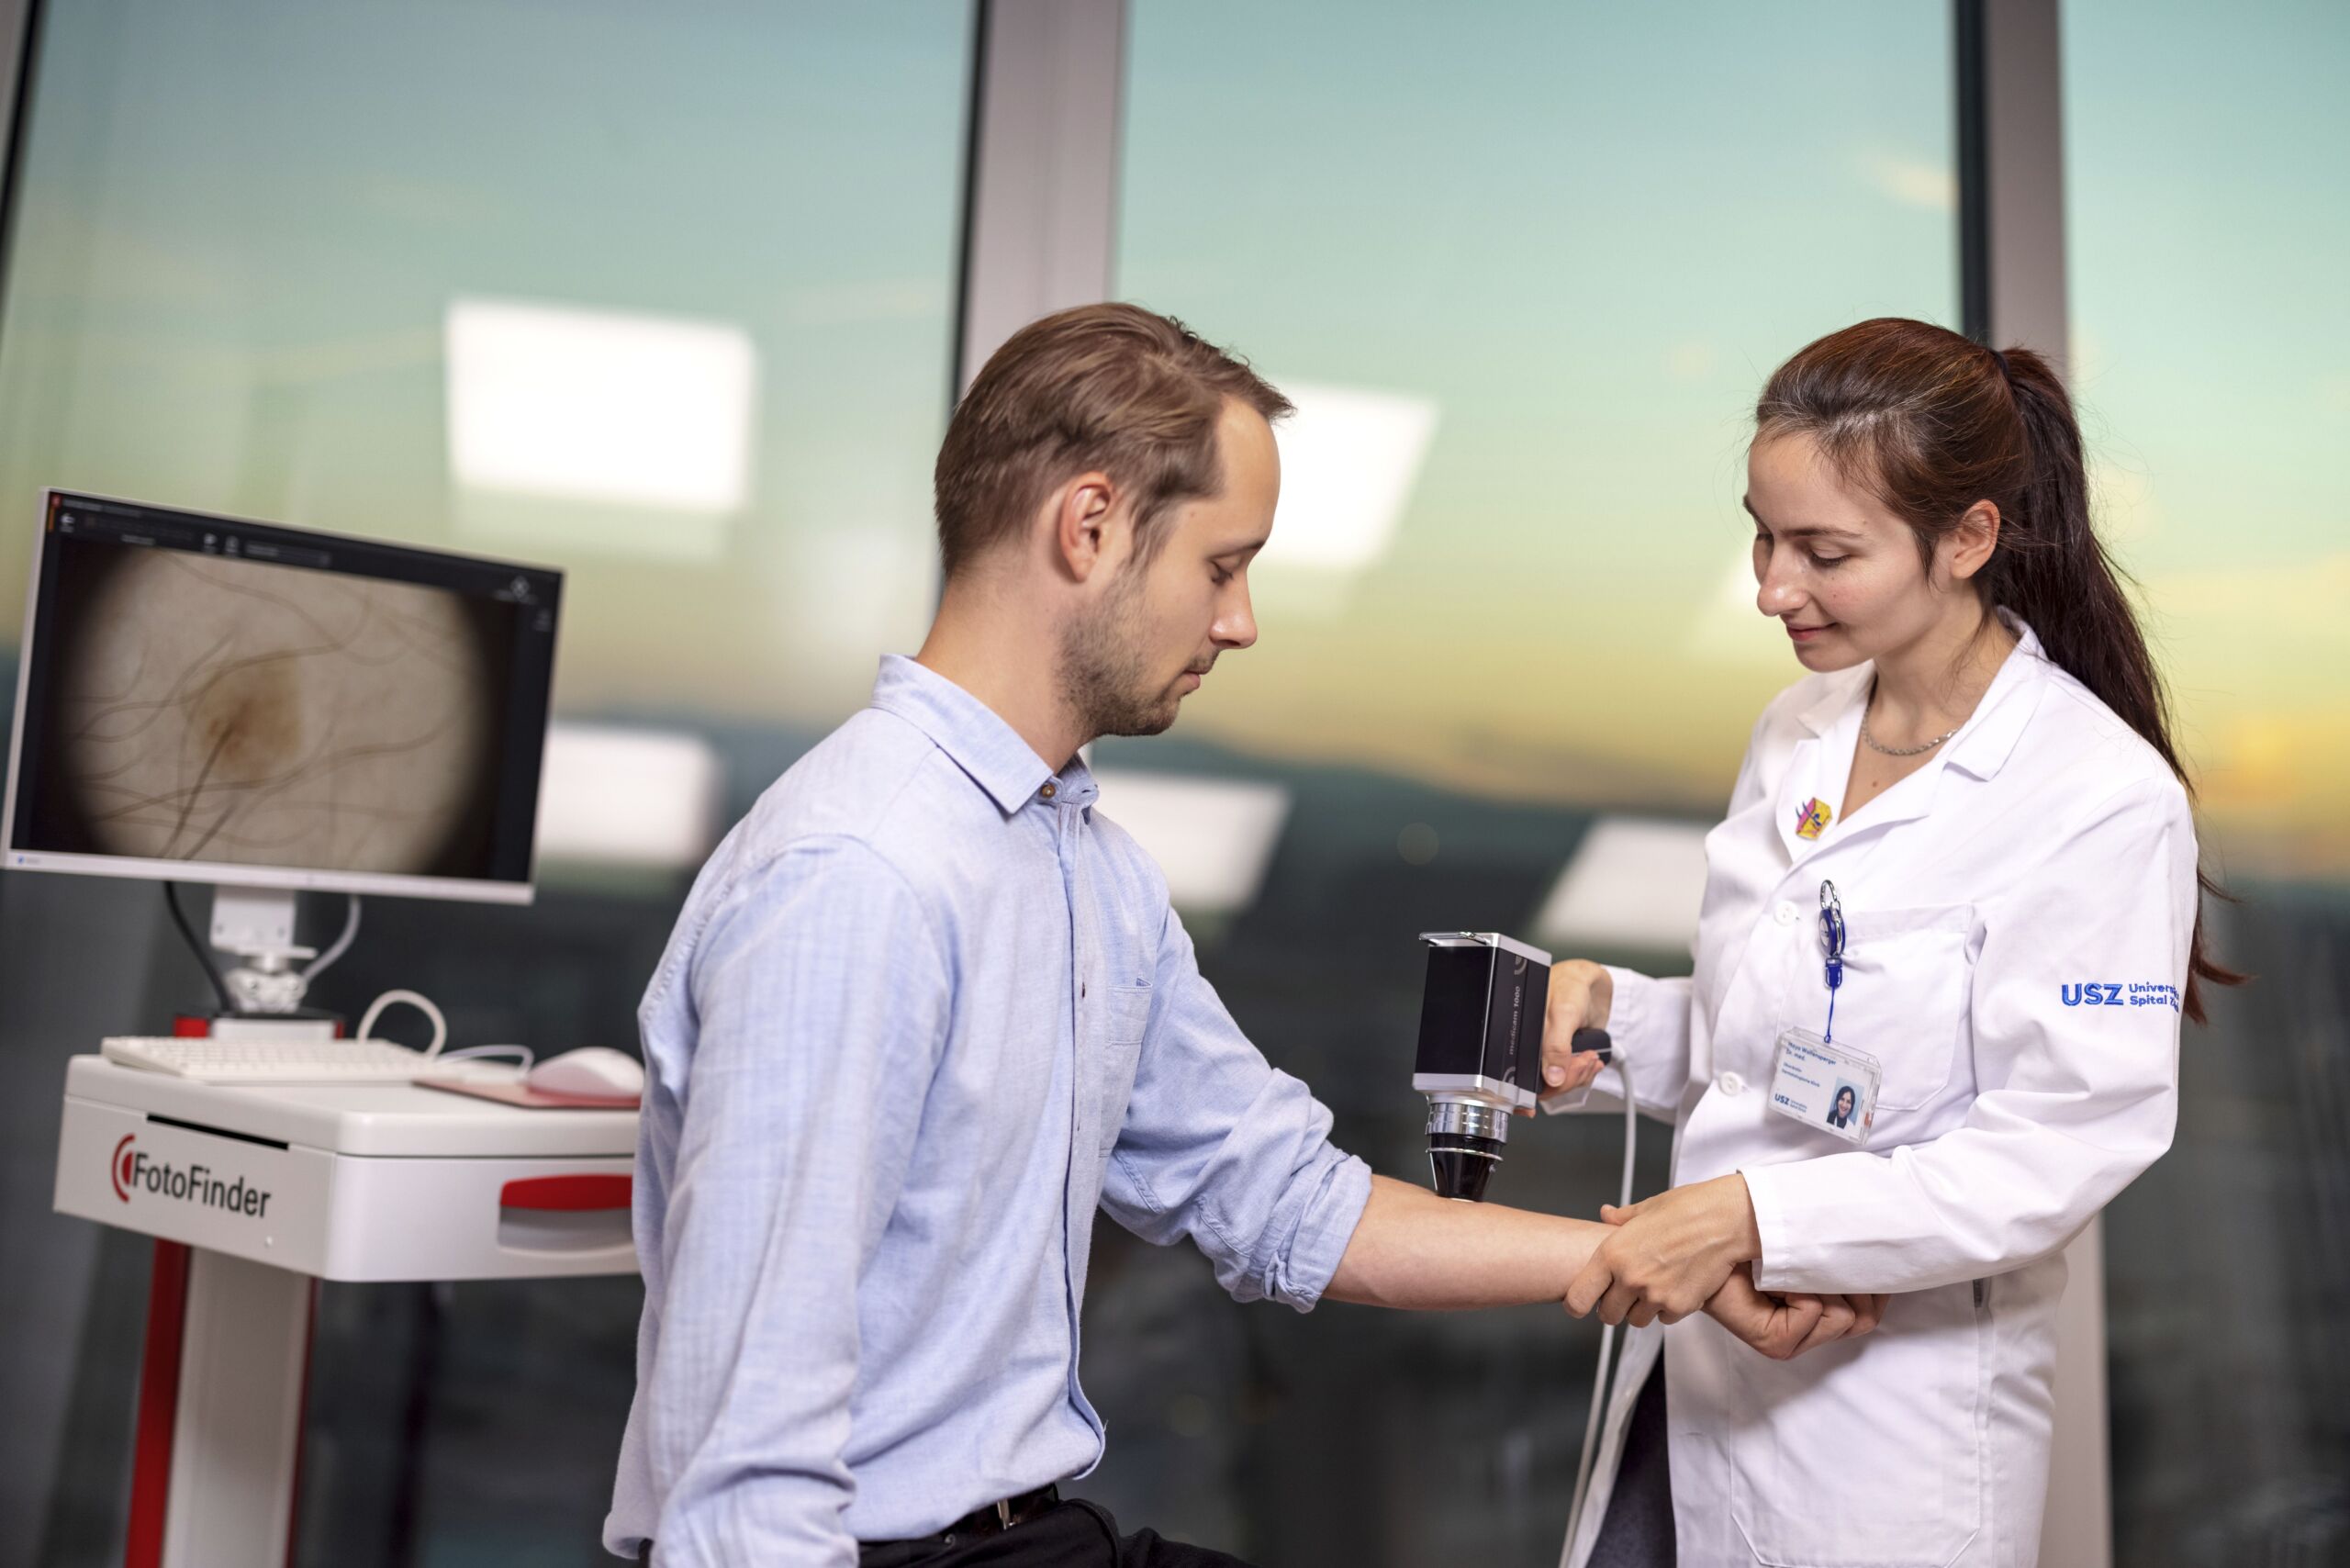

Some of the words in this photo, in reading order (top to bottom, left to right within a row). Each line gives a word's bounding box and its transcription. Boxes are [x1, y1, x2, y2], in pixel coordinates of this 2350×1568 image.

[2062, 983, 2124, 1006] USZ
[2130, 994, 2167, 1007] Spital
[1774, 1092, 1790, 1105] USZ
[132, 1152, 272, 1218] FotoFinder
